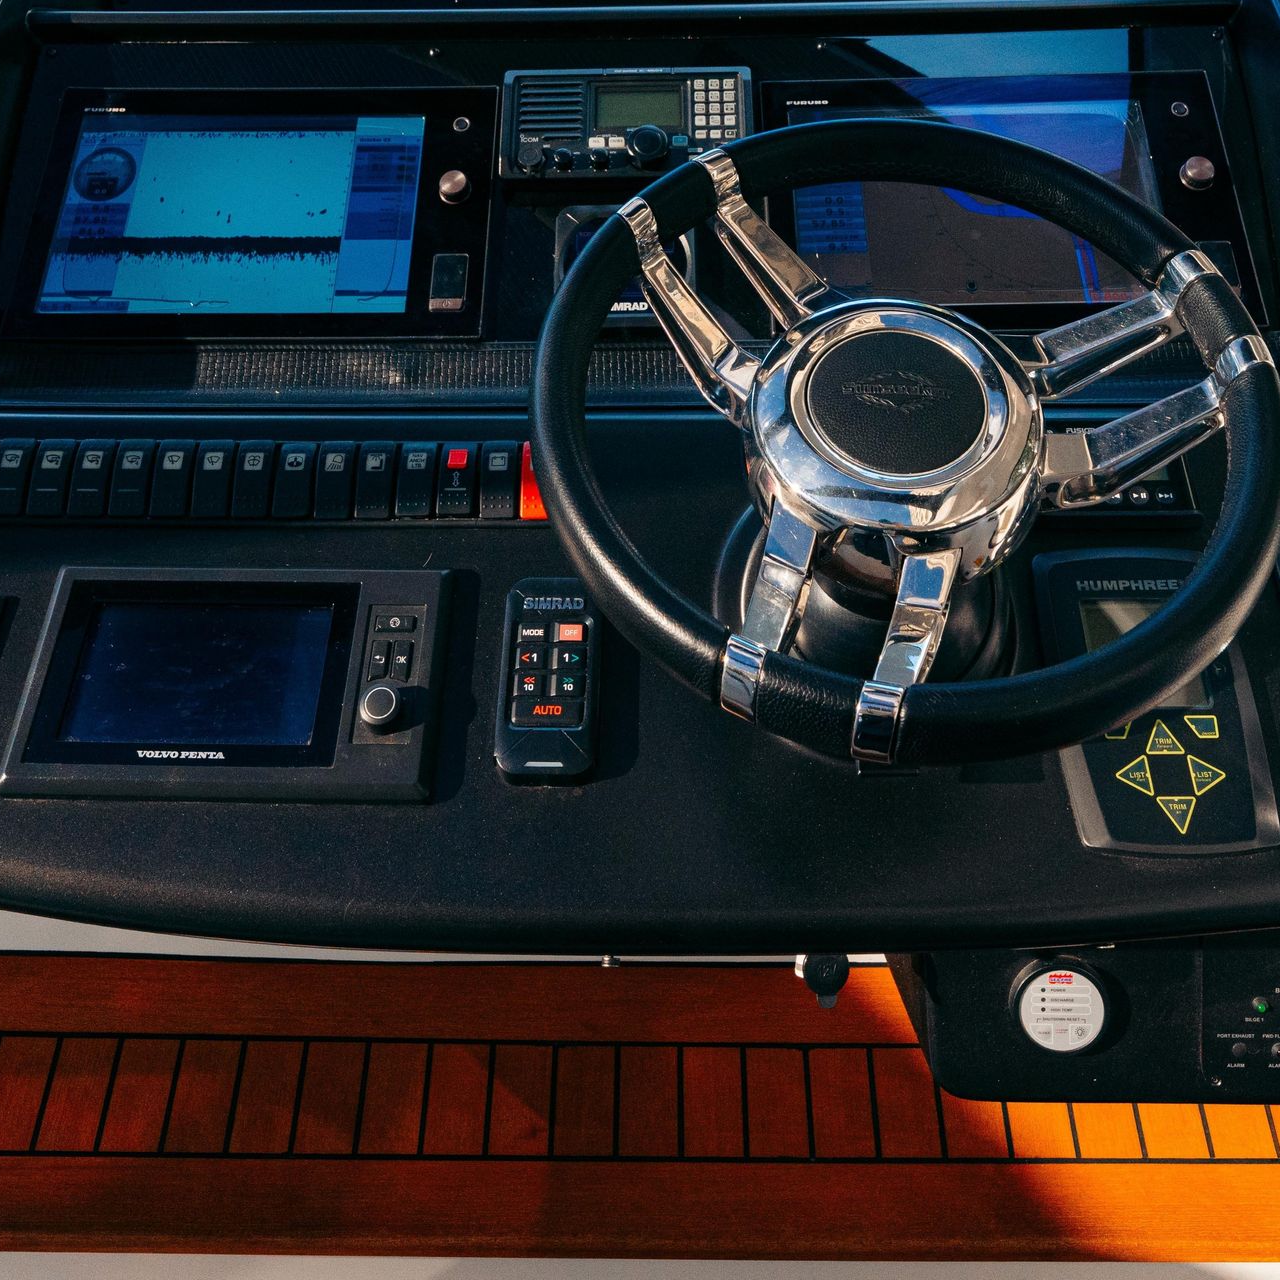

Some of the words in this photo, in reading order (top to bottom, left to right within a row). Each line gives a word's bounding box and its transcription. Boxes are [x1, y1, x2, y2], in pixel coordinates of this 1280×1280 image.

[611, 302, 649, 311] MRAD
[1076, 579, 1183, 591] HUMPHREE
[523, 597, 584, 610] SIMRAD
[522, 628, 545, 636] MODE
[395, 655, 407, 663] OK
[533, 705, 562, 715] AUTO
[136, 750, 179, 759] VOLVO
[180, 751, 226, 759] PENTA
